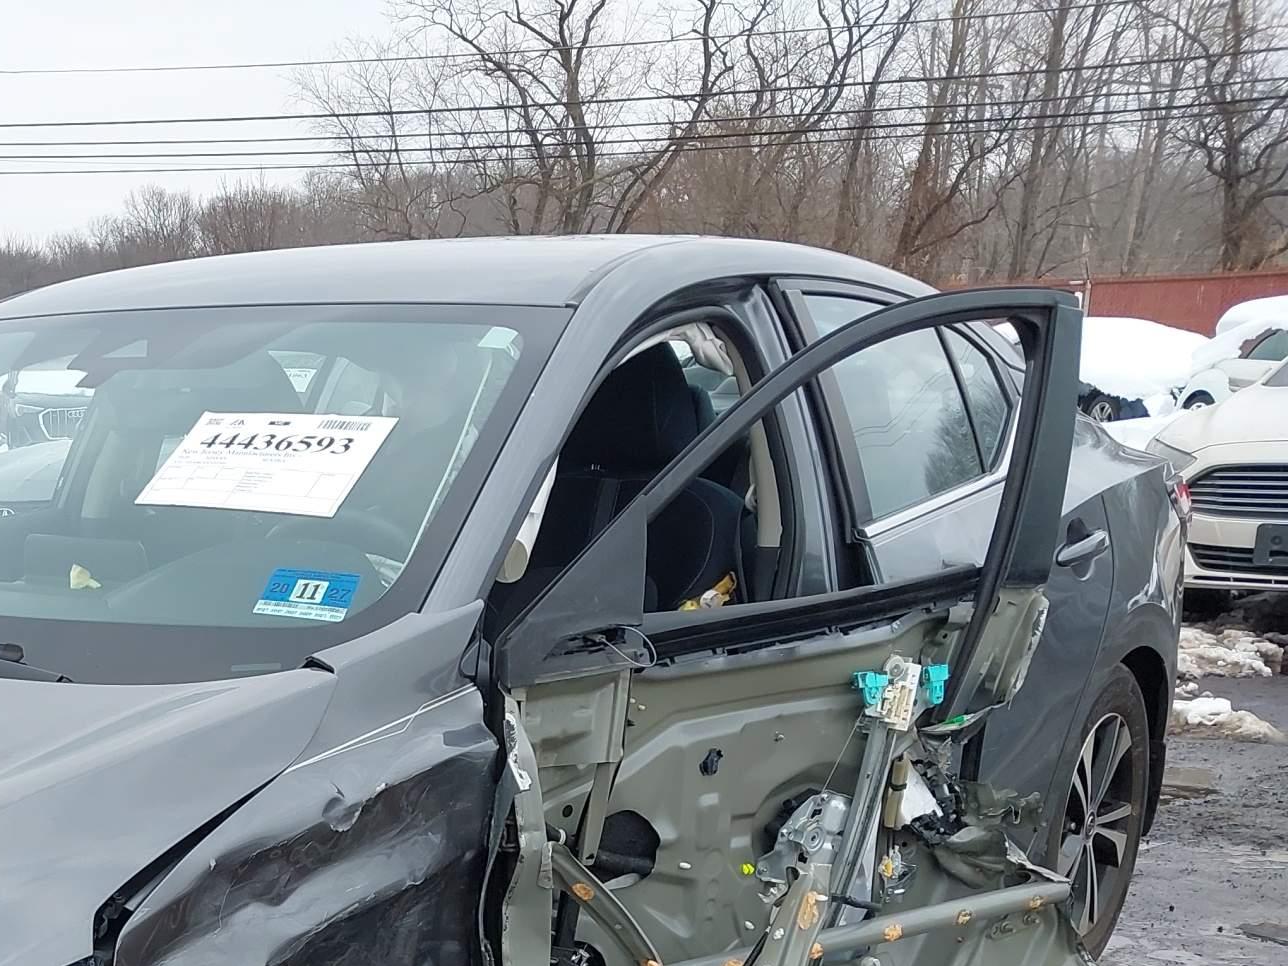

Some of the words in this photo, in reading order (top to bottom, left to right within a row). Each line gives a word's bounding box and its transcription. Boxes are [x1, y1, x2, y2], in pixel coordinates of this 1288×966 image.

[200, 432, 355, 454] 44436593
[269, 582, 290, 594] 20
[295, 582, 321, 600] 11
[328, 589, 352, 600] 27
